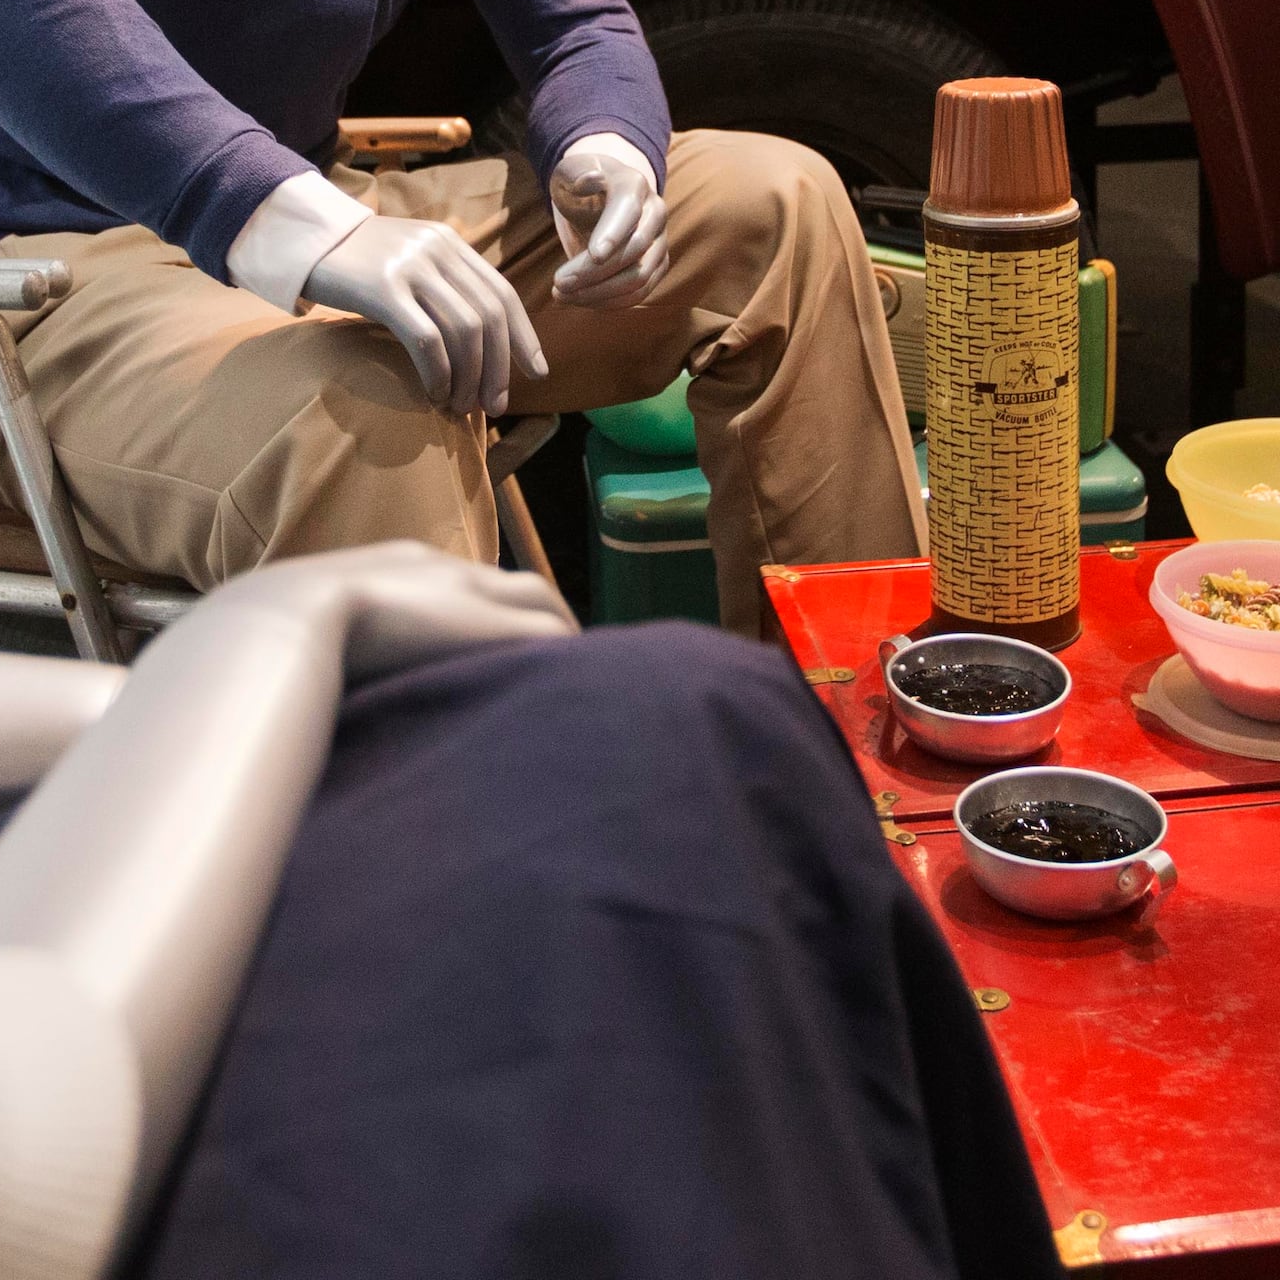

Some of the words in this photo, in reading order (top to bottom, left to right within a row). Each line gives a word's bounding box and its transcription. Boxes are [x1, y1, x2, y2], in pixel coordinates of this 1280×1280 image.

[994, 342, 1017, 354] KEEPS
[1040, 341, 1057, 349] COLD
[997, 389, 1056, 404] SPORTSTER
[995, 411, 1029, 424] VACUUM
